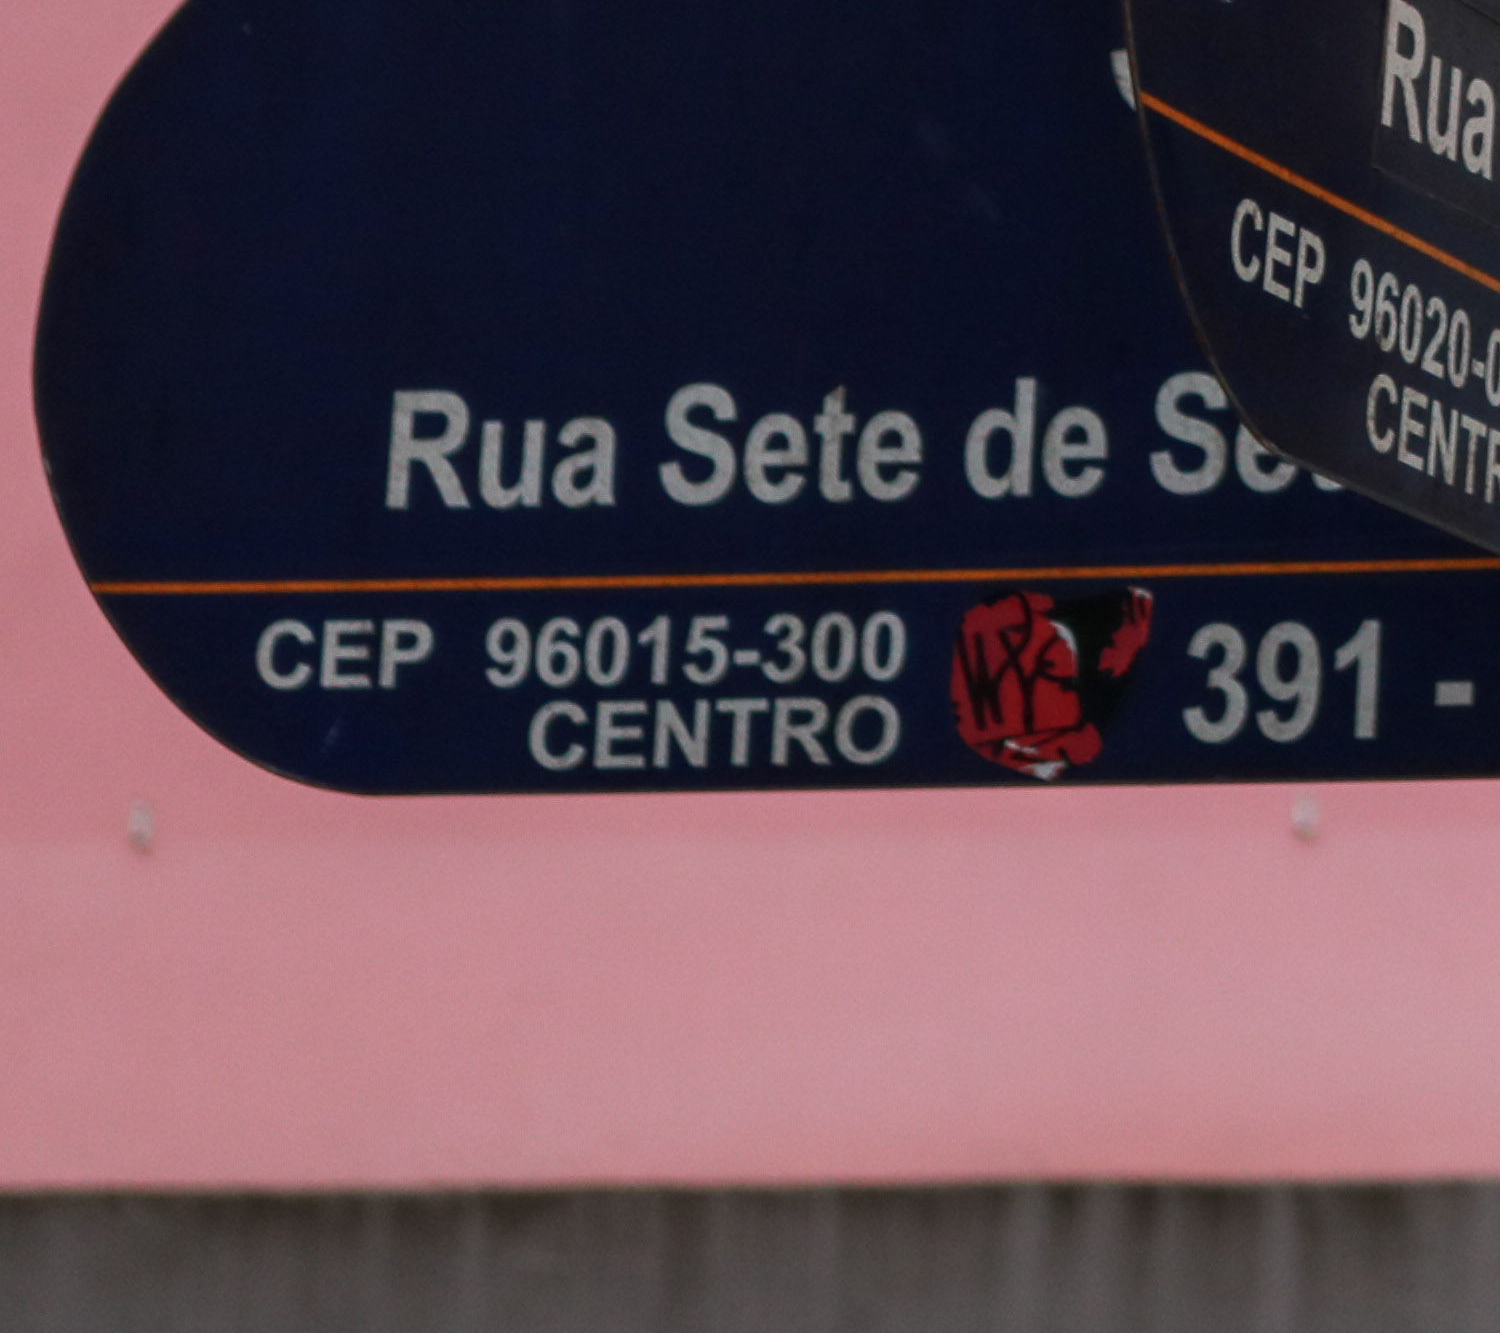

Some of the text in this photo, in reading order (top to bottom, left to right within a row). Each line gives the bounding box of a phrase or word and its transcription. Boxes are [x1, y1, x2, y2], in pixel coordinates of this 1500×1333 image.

[1231, 198, 1325, 309] CEP
[387, 390, 616, 509] Rua
[660, 383, 923, 504] Sete
[965, 377, 1108, 498] de
[256, 620, 435, 689] CEP
[485, 612, 907, 688] 96015-300
[1184, 620, 1380, 741] 391
[1438, 682, 1472, 704] -
[529, 696, 901, 770] CENTRO
